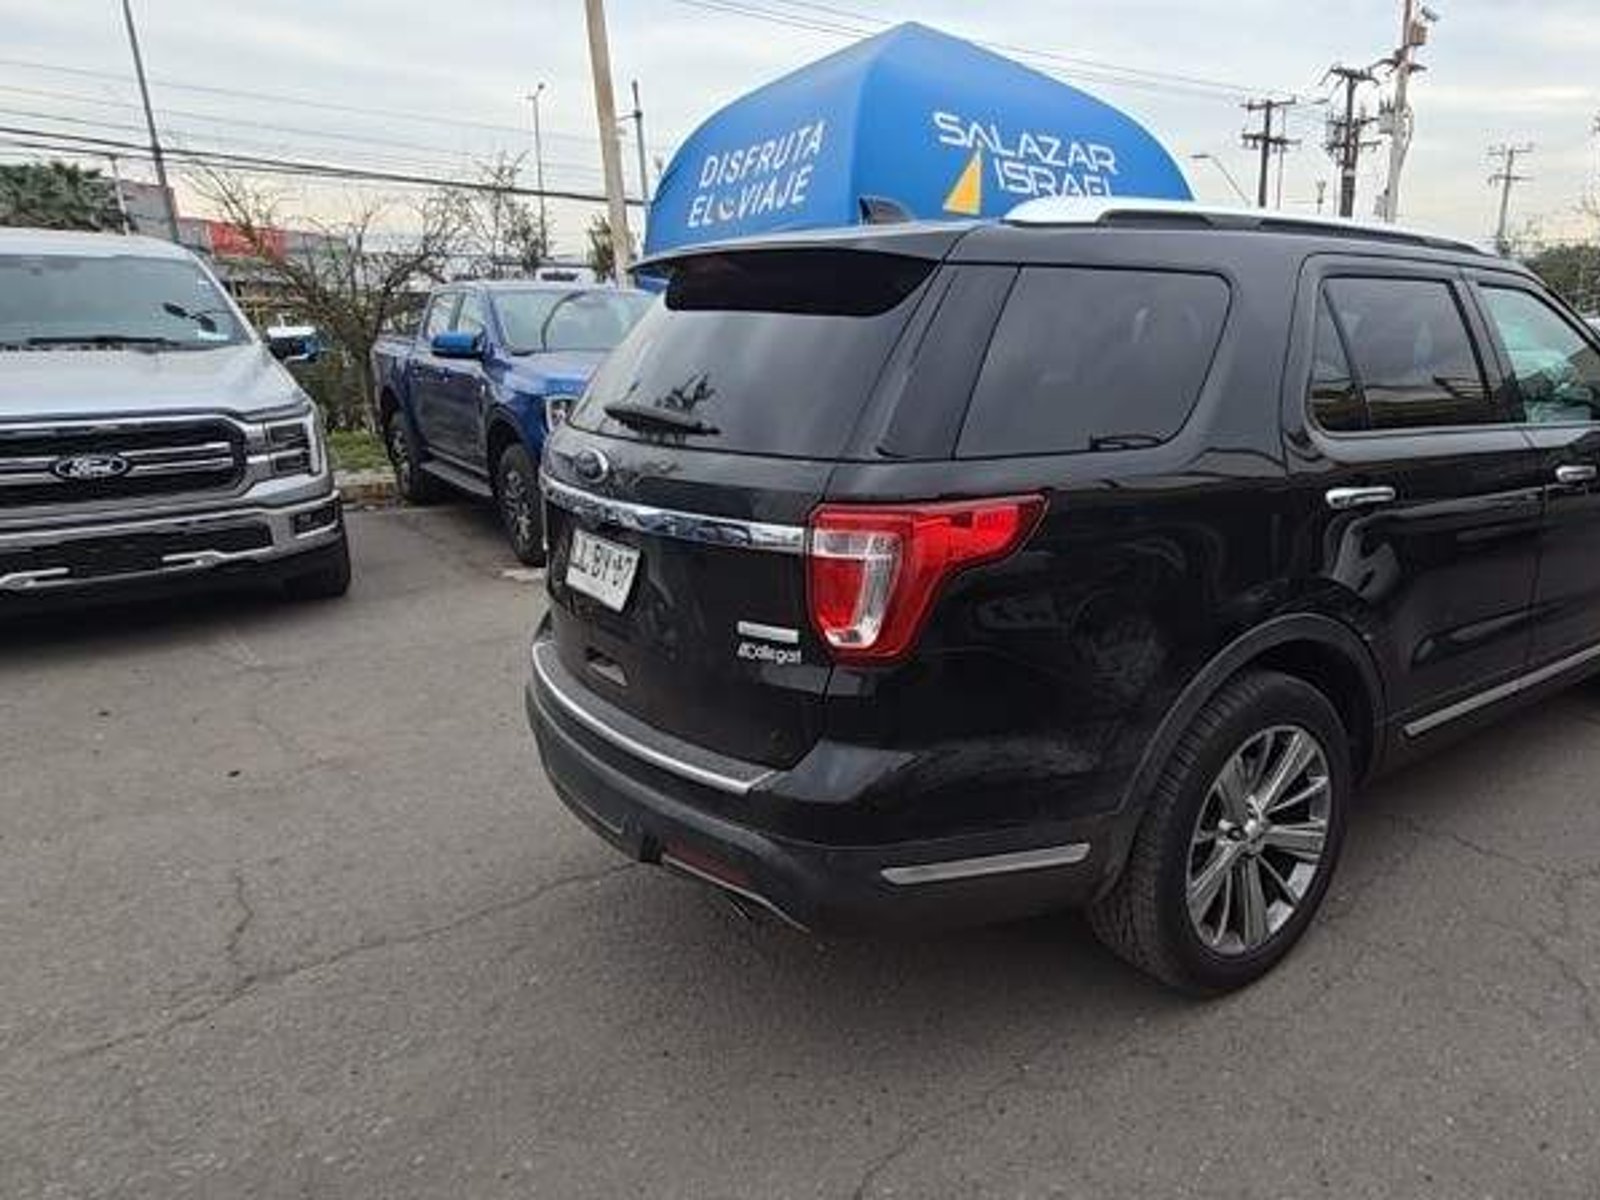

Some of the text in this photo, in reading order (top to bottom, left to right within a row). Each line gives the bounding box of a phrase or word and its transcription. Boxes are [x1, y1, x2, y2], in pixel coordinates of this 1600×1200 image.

[698, 121, 826, 188] DISFRUTA
[932, 111, 1119, 175] SALAZAR
[687, 165, 813, 229] EL VIAJE
